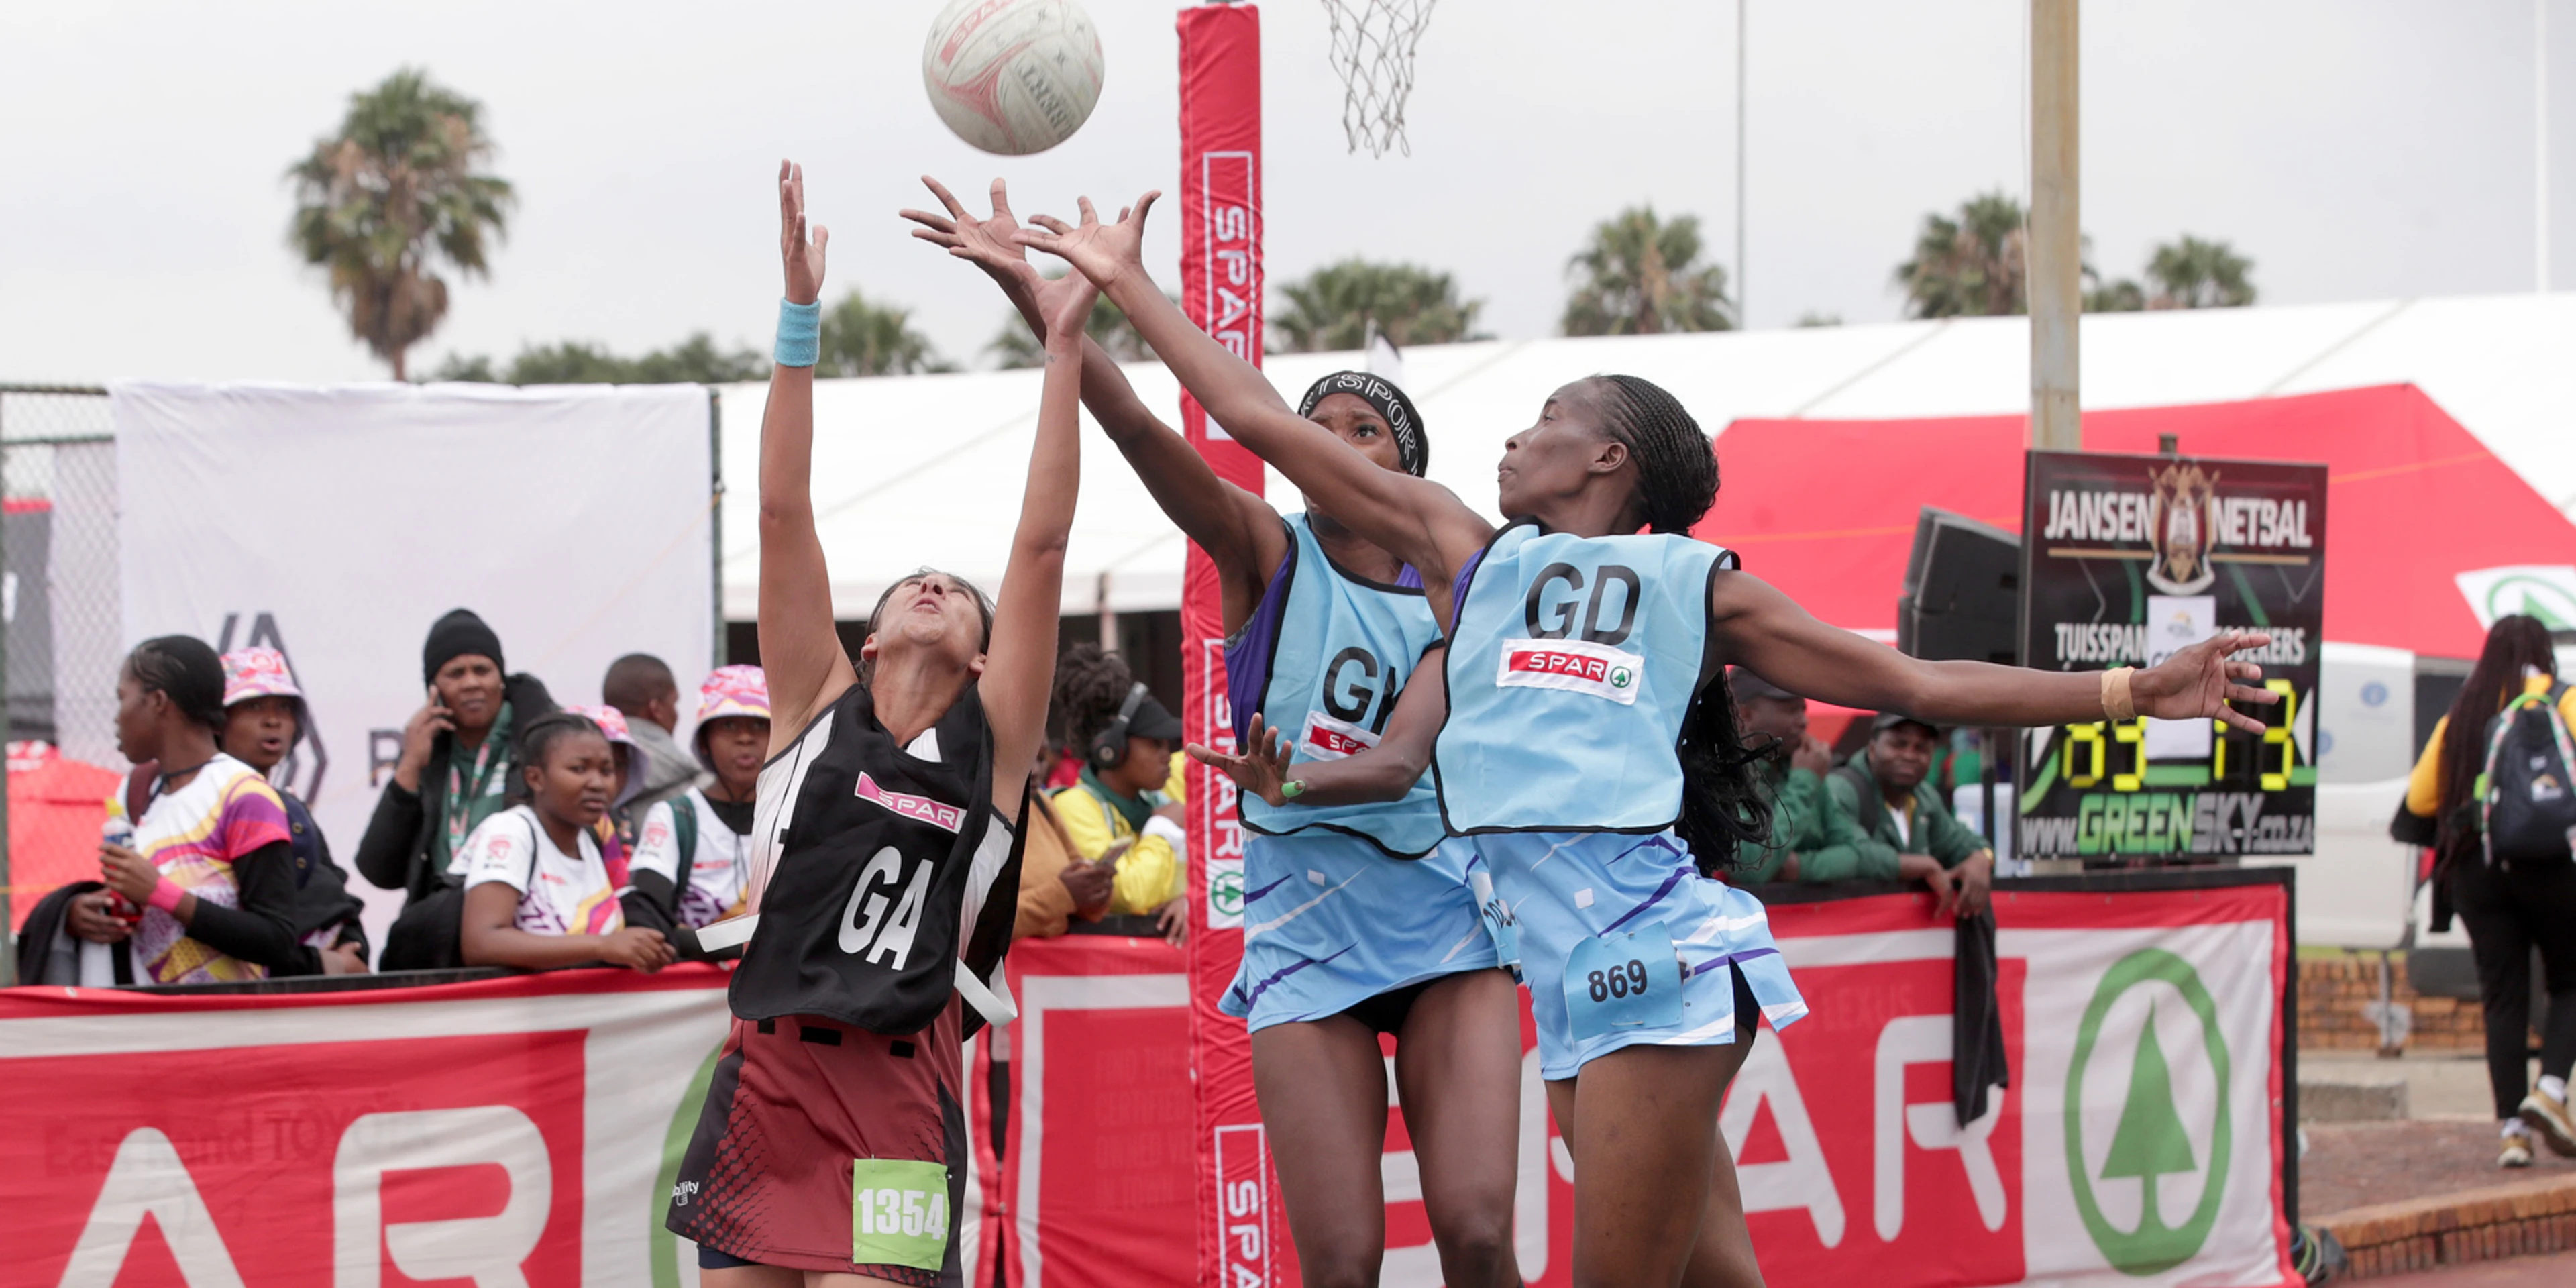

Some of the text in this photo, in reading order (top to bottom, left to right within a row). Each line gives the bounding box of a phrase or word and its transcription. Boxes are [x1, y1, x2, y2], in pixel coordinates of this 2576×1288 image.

[2045, 490, 2313, 549] JANSEN NETBAL
[1524, 561, 1641, 646] GD
[1528, 652, 1605, 680] SPAR
[2054, 622, 2149, 663] TUISSPAN
[2215, 625, 2306, 665] OEKERS
[1329, 733, 1368, 754] SP
[879, 790, 957, 830] SPAR
[837, 845, 934, 971] GA
[1587, 958, 1648, 1003] 869
[857, 1186, 945, 1240] 1354
